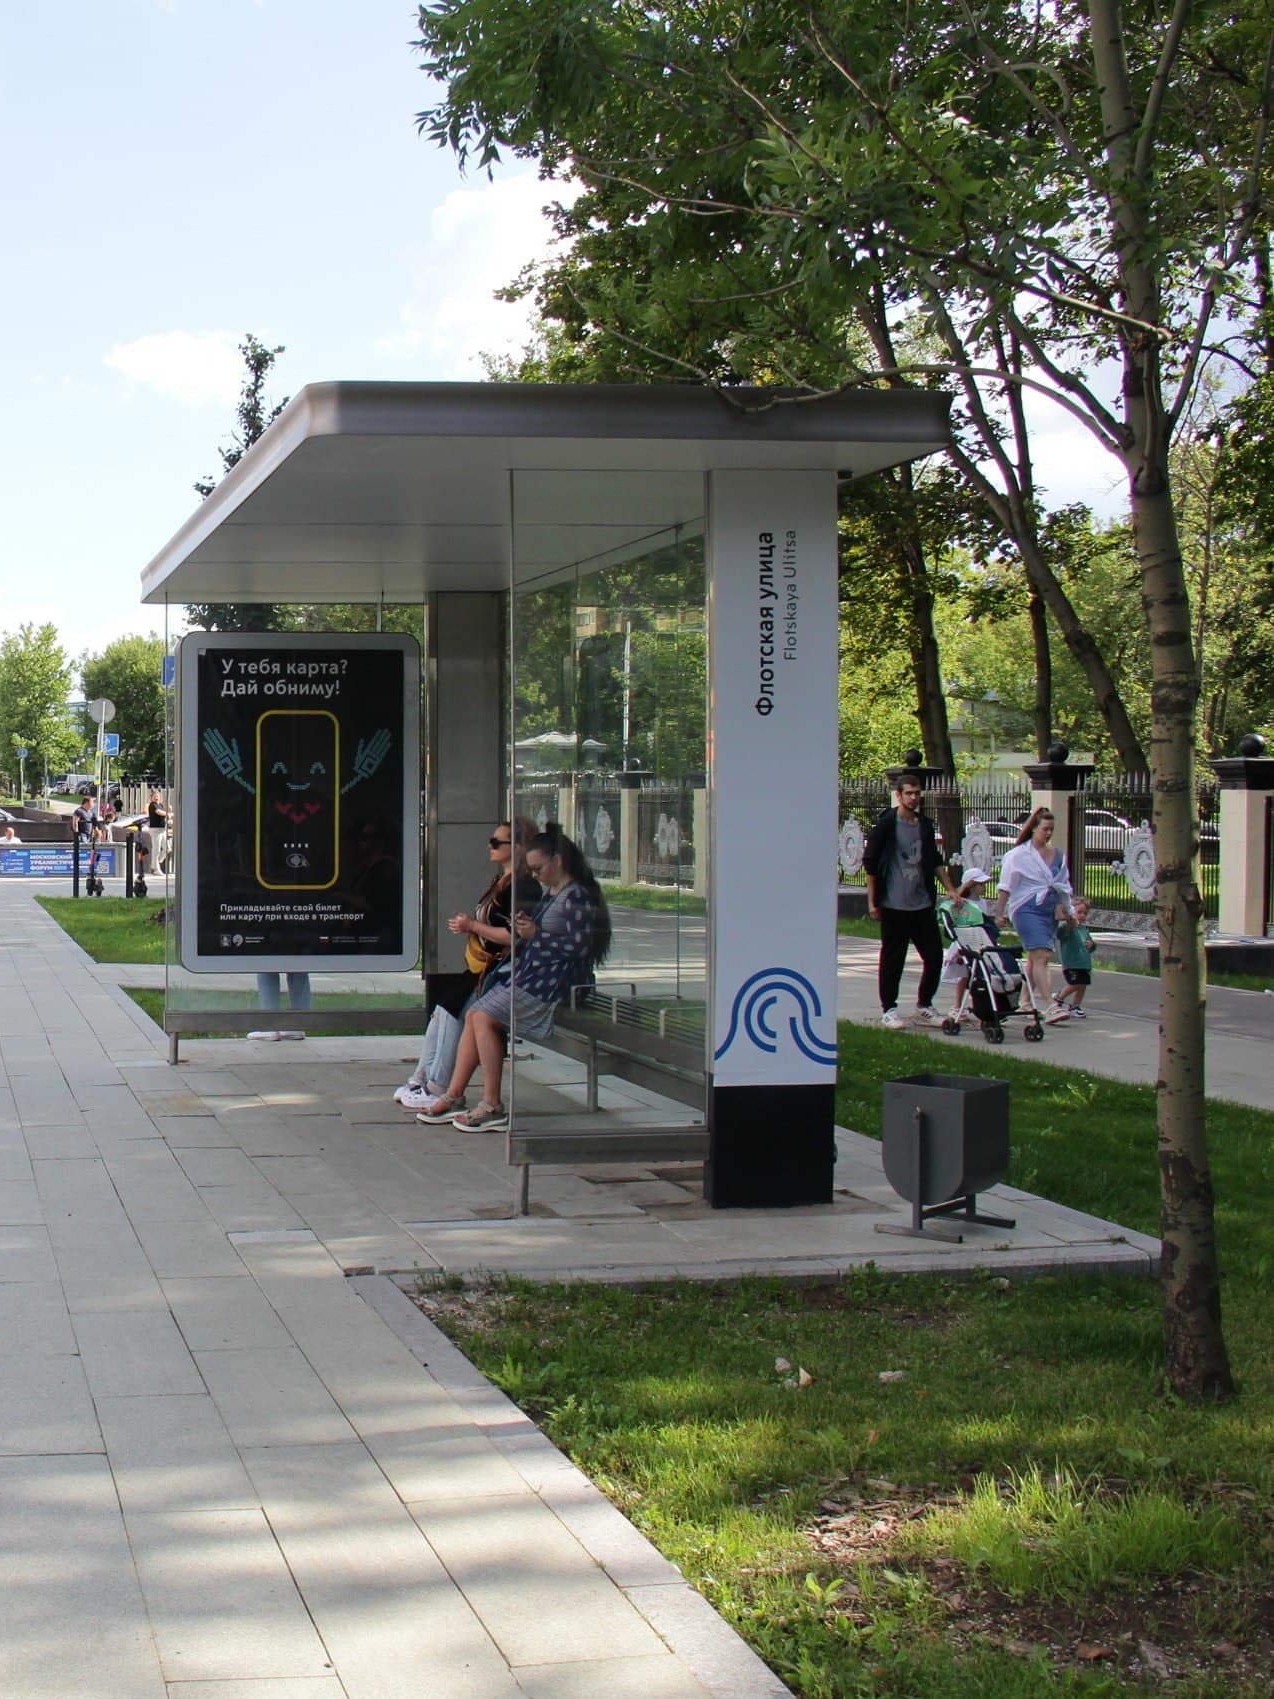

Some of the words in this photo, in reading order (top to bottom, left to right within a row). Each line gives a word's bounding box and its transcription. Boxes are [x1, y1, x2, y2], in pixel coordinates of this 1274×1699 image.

[759, 532, 778, 600] улица
[783, 530, 797, 578] Ulitsa
[783, 585, 800, 661] Flotskaya
[221, 659, 234, 675] У
[238, 659, 280, 675] тебя
[287, 659, 348, 677] карта?
[755, 607, 775, 716] Флотская
[221, 679, 258, 697] Дай
[264, 680, 341, 698] обниму!
[220, 903, 291, 912] Прикладывайте
[293, 903, 314, 912] свой
[315, 903, 342, 912] билет
[238, 914, 263, 922] карту
[265, 914, 282, 922] при
[319, 913, 365, 922] транспорт
